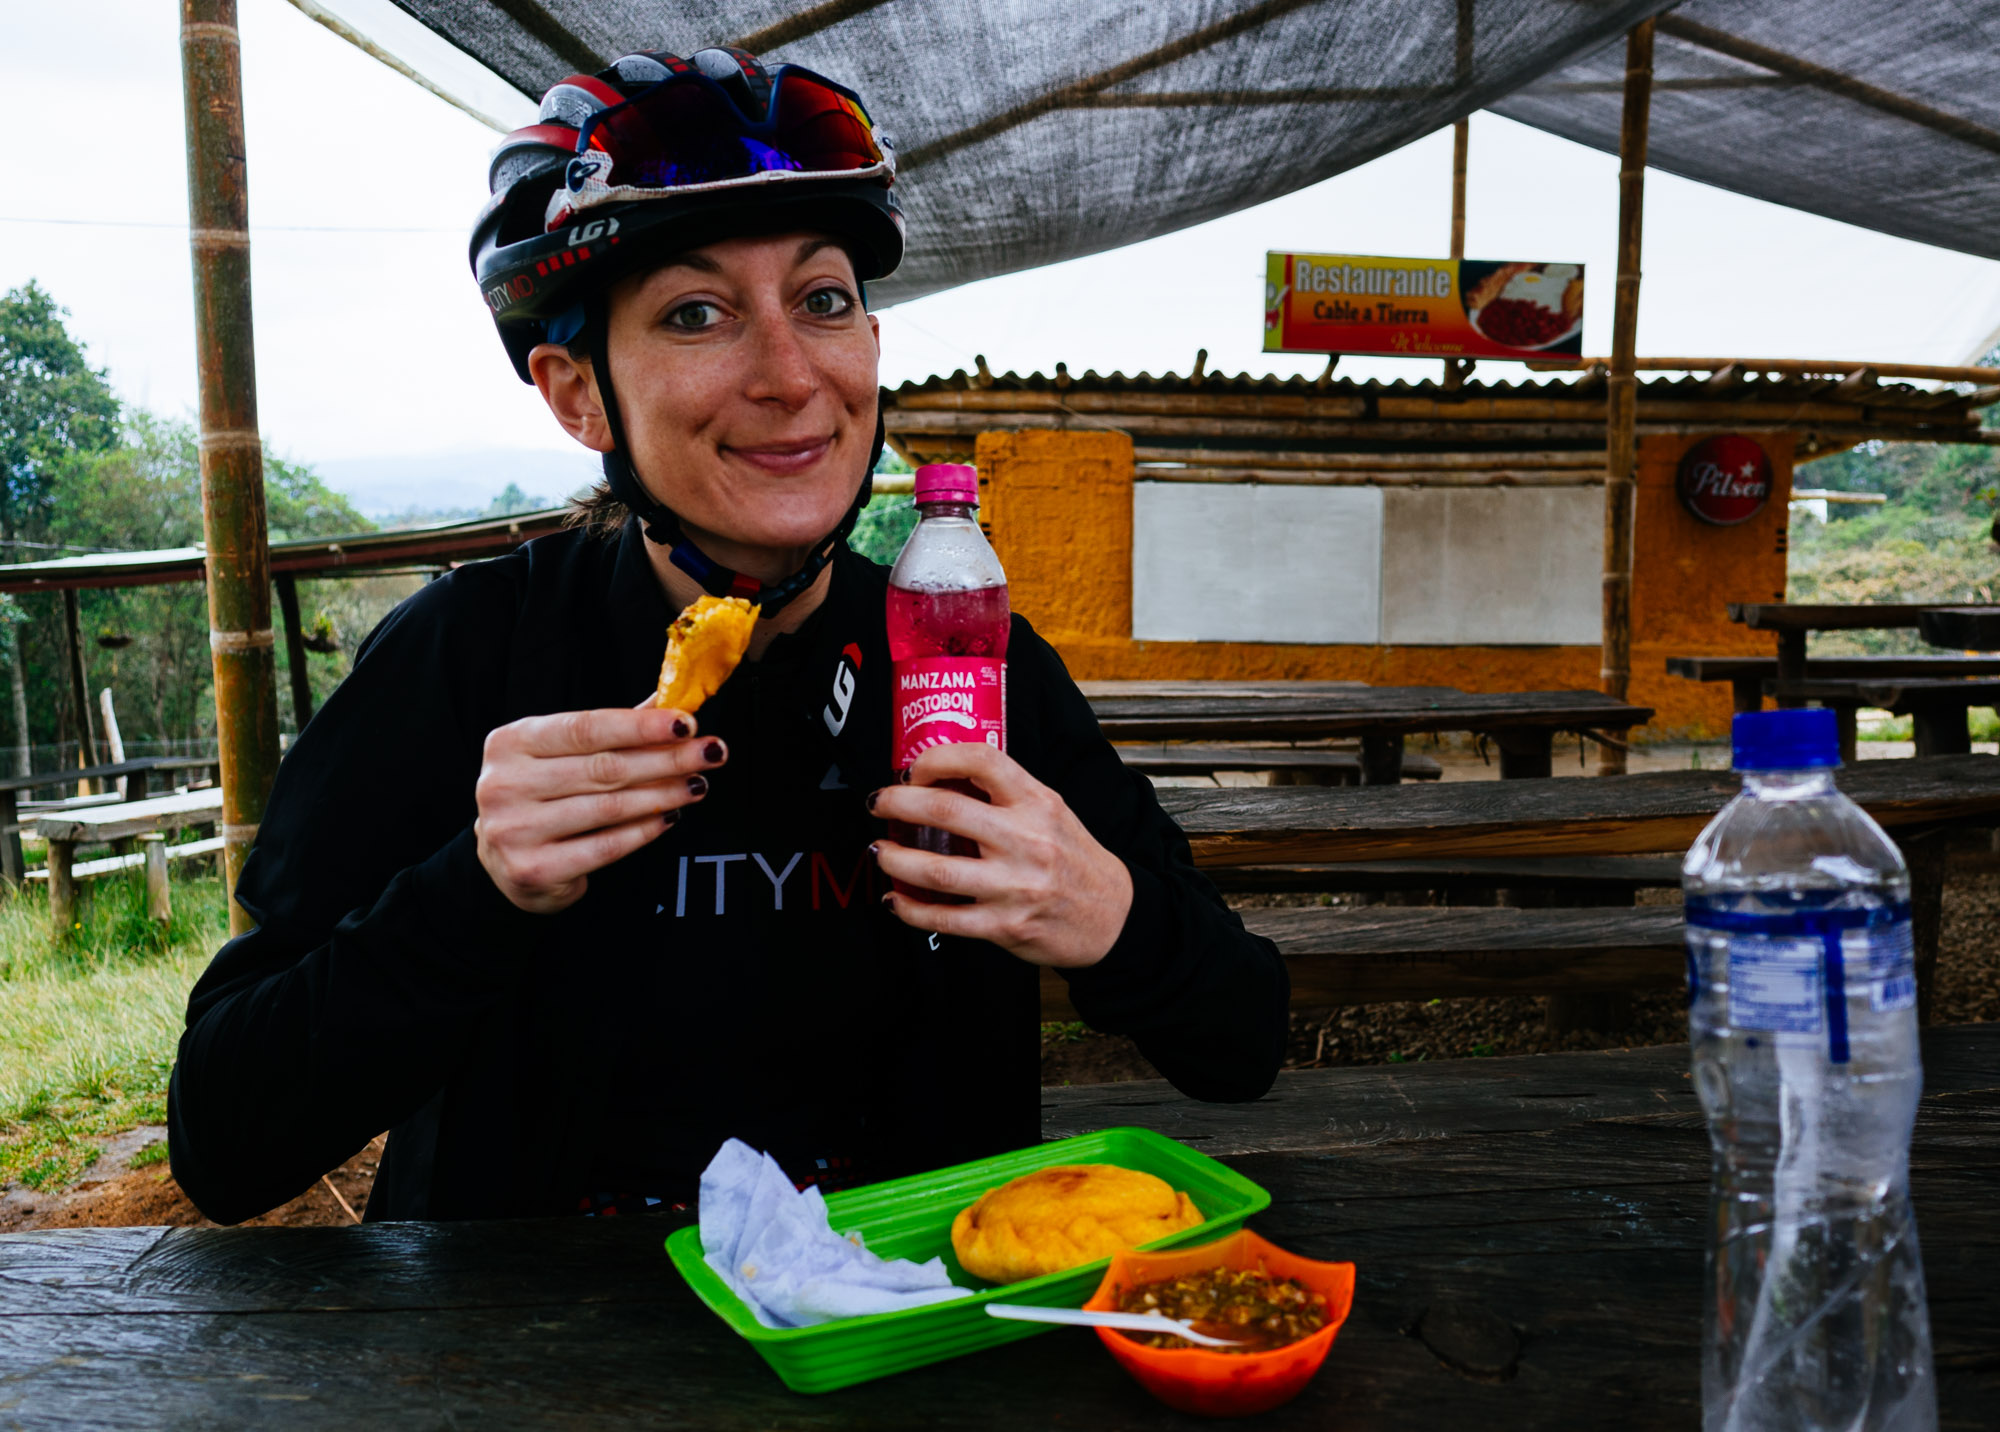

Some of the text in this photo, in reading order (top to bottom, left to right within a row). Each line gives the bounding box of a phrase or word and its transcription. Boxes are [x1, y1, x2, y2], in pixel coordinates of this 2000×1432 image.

[488, 274, 534, 311] CITYMD
[1295, 260, 1450, 298] Restaurante
[1313, 301, 1429, 324] Cable a Tierra
[1692, 462, 1765, 497] Pilsen
[901, 671, 976, 690] MANZANA
[902, 691, 974, 727] POSTOBON
[656, 852, 874, 917] ITYM
